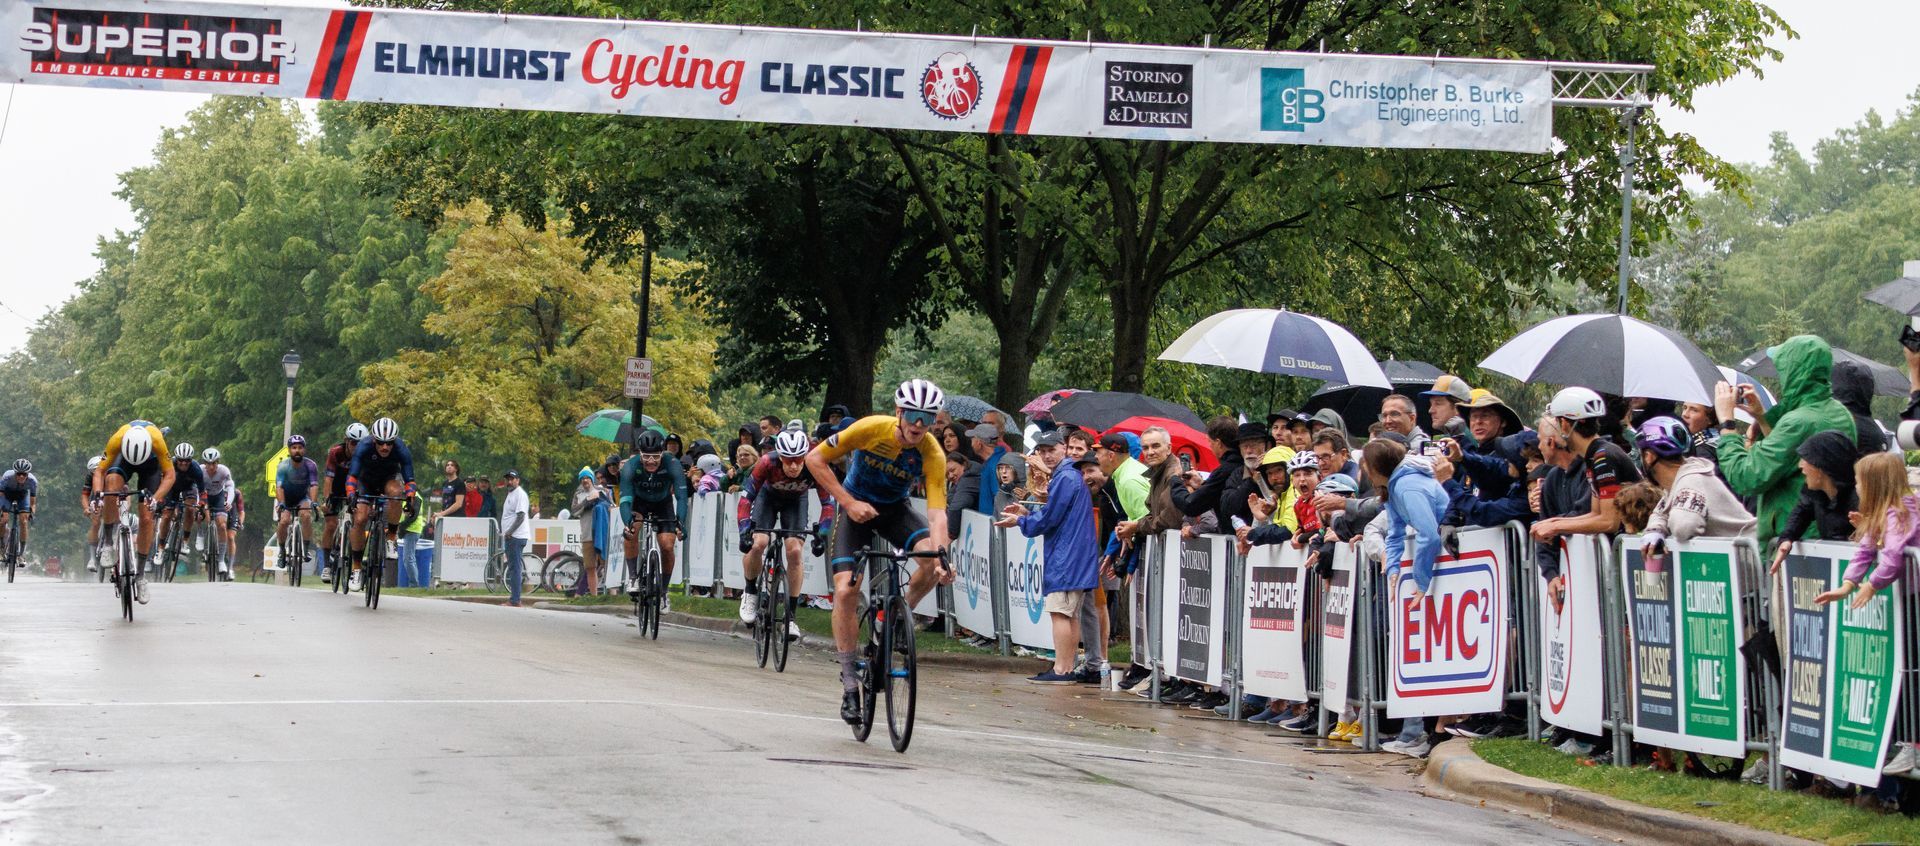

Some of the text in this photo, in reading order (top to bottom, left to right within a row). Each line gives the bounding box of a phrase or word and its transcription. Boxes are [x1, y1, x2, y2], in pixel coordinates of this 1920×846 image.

[19, 21, 296, 64] SUPERIOR
[34, 62, 277, 84] AMBULANCE SERVICE
[374, 38, 905, 106] ELMHURST Cycling CLASSIC
[1110, 65, 1183, 84] STORINO
[1109, 86, 1189, 105] RAMELLO
[1329, 79, 1524, 104] Christopher B. Burke
[1109, 106, 1188, 124] &DURKIN
[1378, 102, 1524, 126] Engineering, Ltd.
[627, 371, 650, 380] PARKING
[634, 362, 645, 370] NO
[1297, 359, 1333, 372] Wilson
[443, 533, 488, 549] Healthy Driven
[567, 534, 582, 544] EL
[967, 552, 990, 588] POWER
[1181, 541, 1210, 575] STORINO,
[1008, 561, 1044, 595] C&C PO
[1180, 578, 1211, 608] RAMELLO
[1249, 581, 1298, 611] SUPERIOR
[1685, 580, 1727, 614] ELMHURST
[1179, 615, 1210, 645] &DURKIN
[1276, 621, 1295, 630] SERVICE
[1636, 603, 1671, 644] CYCLING
[1687, 617, 1728, 656] TWILIGHT
[1793, 613, 1823, 660] CYCLING
[1639, 645, 1672, 688] CLASSIC
[1842, 631, 1888, 677] TWILIGHT
[1697, 659, 1721, 701] MILE
[1791, 660, 1822, 707] CLASSIC
[1848, 677, 1875, 724] MILE
